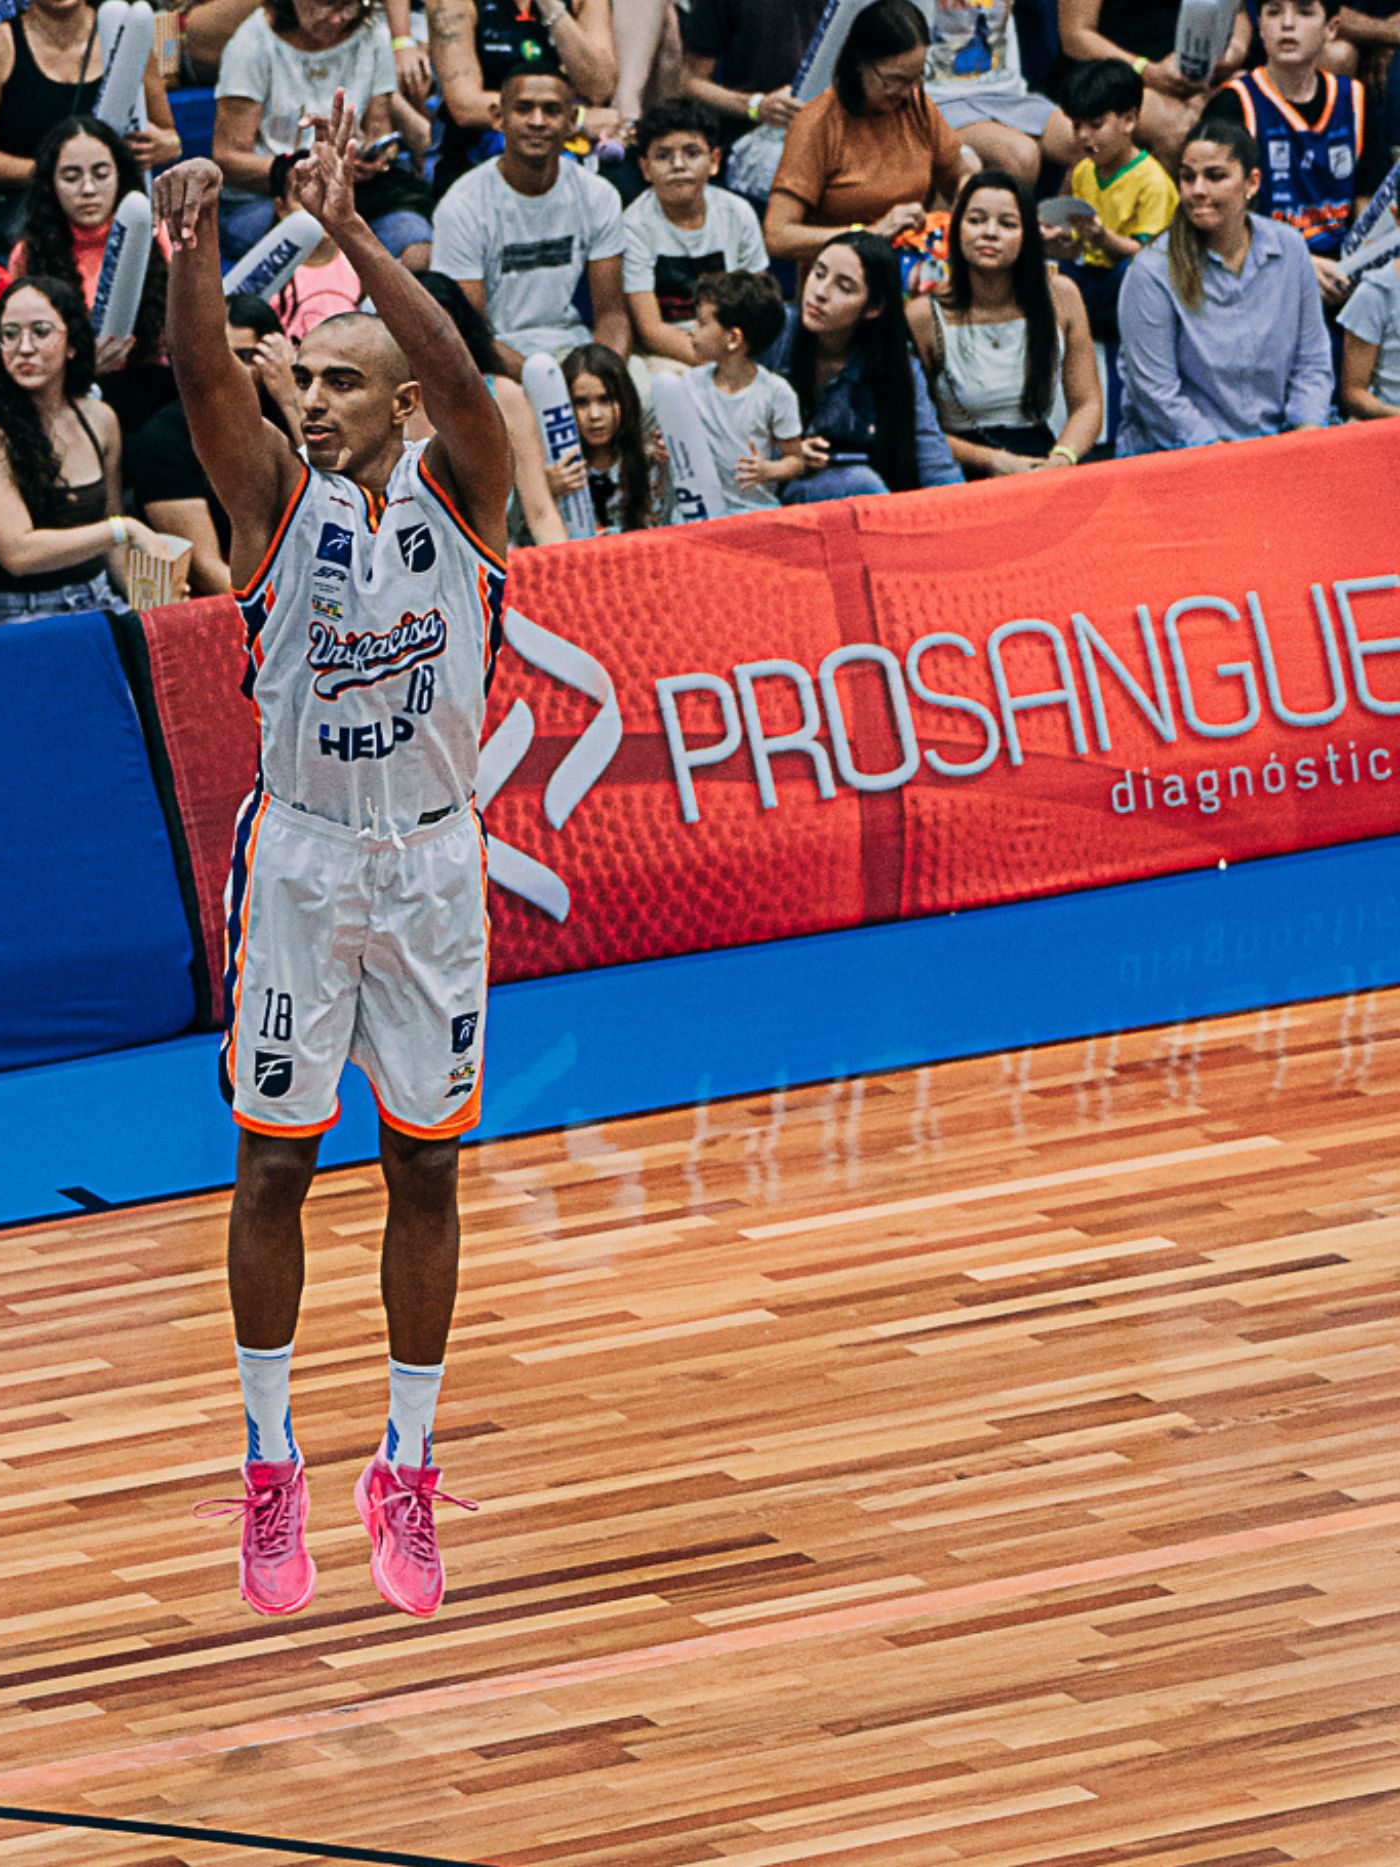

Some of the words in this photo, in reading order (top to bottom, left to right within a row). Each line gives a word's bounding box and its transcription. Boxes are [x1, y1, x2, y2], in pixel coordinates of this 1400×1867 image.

[542, 402, 583, 465] HEL
[403, 664, 435, 714] 18
[655, 574, 1400, 824] PROSANGUE
[319, 715, 415, 762] HELP
[259, 987, 293, 1042] 18
